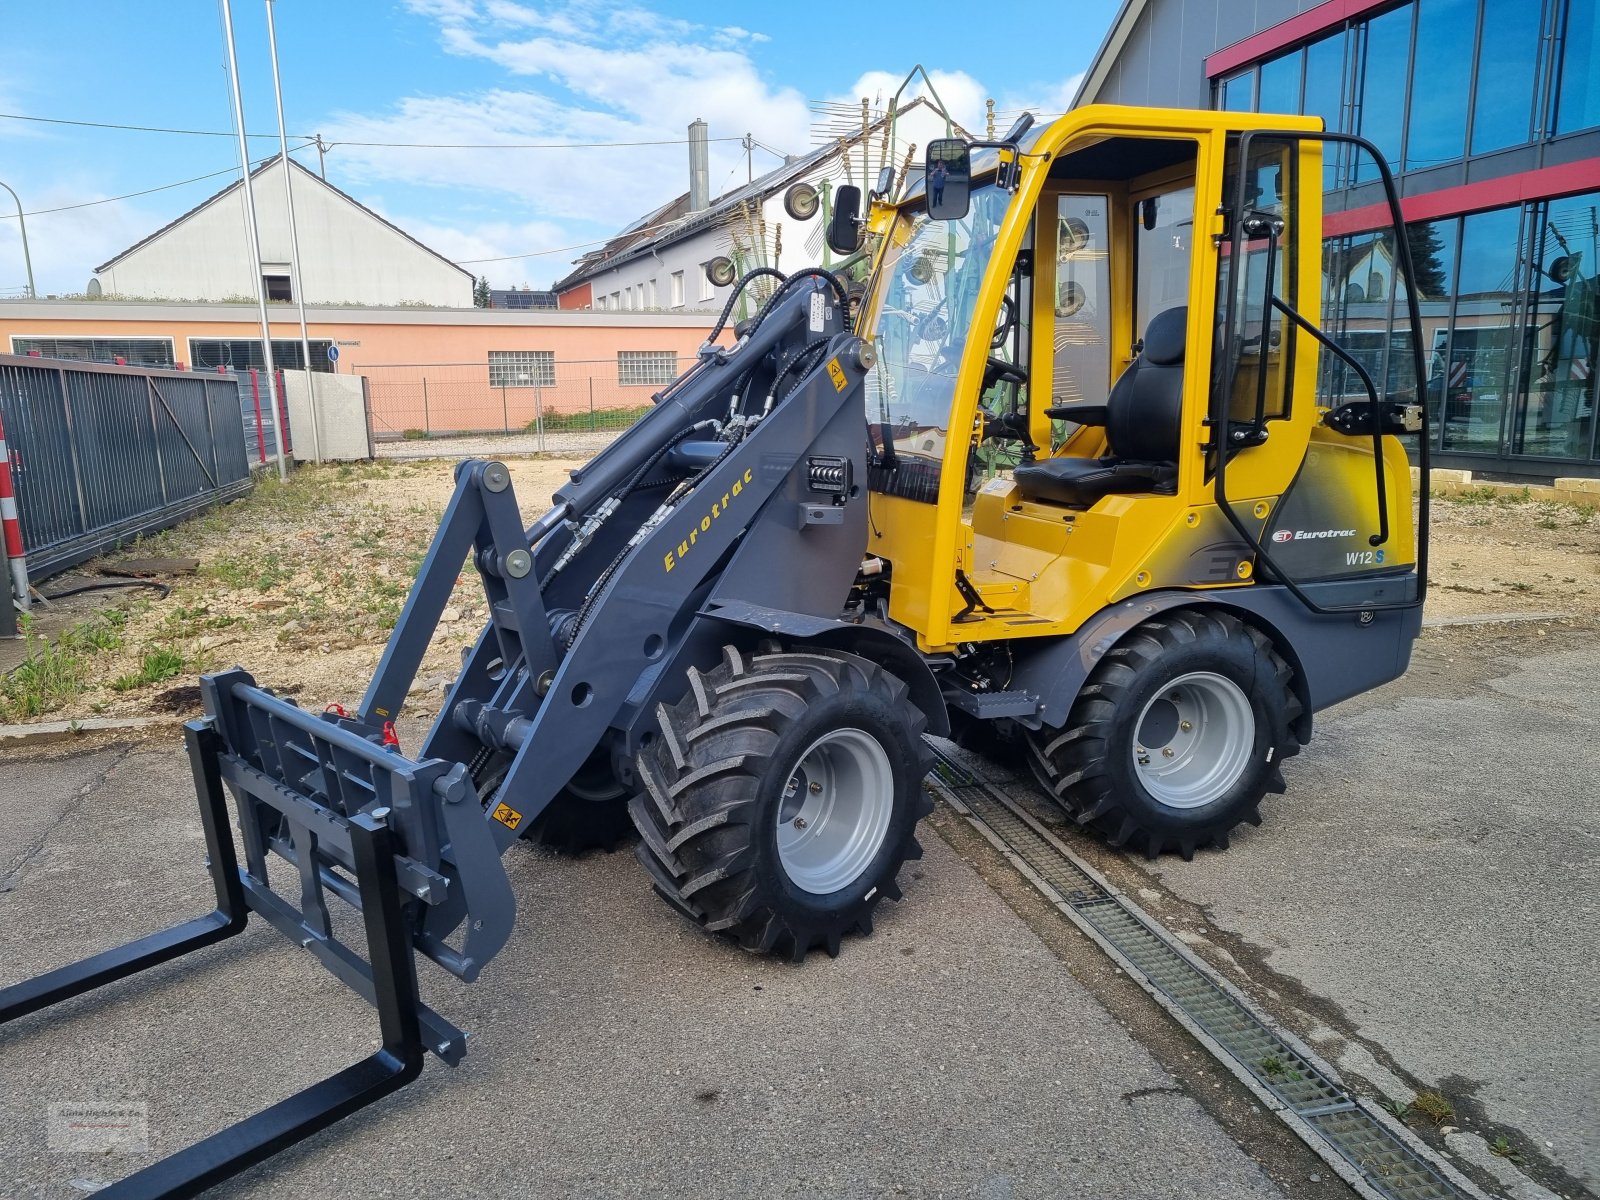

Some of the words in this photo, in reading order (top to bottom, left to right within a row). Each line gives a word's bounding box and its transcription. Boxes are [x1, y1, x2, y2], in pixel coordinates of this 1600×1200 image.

[663, 468, 753, 573] Eurotrac
[1294, 529, 1357, 540] Eurotrac
[1346, 552, 1373, 565] W12
[1375, 550, 1385, 563] S
